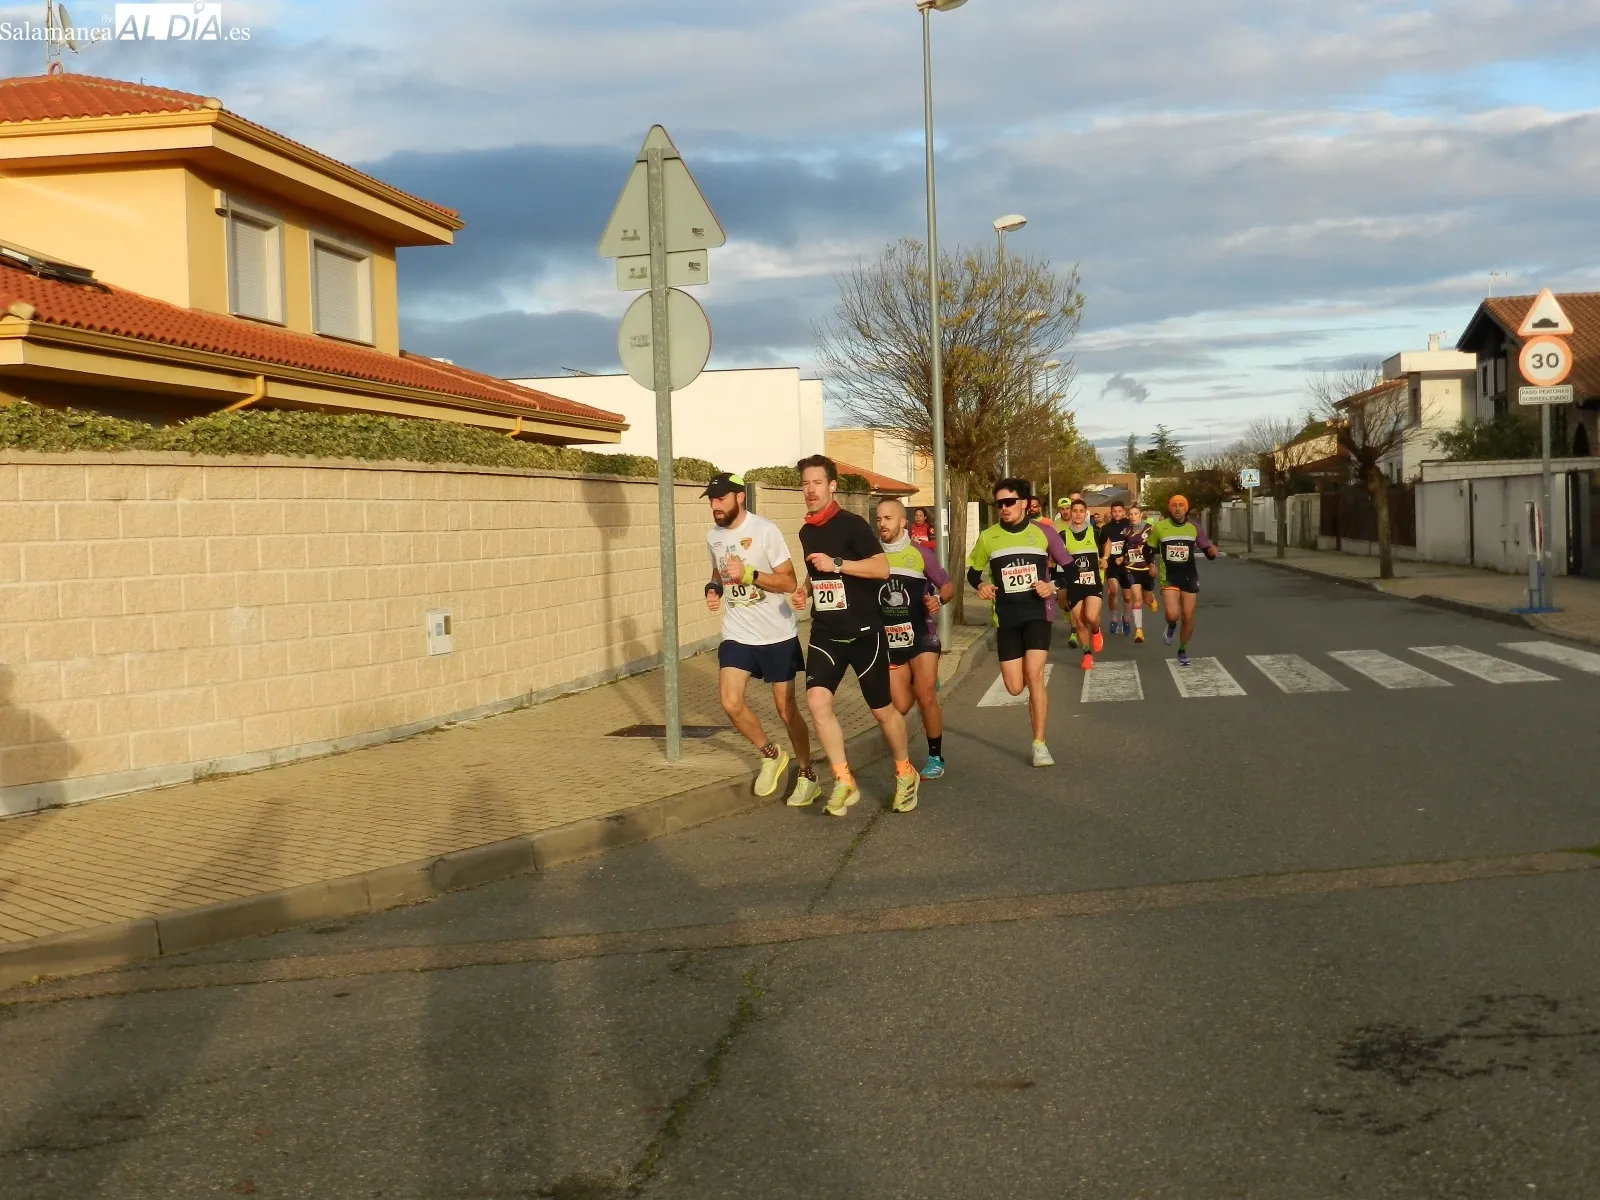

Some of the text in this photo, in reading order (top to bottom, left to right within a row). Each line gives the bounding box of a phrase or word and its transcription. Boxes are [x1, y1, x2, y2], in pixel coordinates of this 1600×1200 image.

[1531, 352, 1560, 369] 30
[1170, 550, 1185, 558] 245
[1008, 573, 1033, 587] 203
[731, 584, 747, 597] 60
[818, 590, 834, 604] 20
[887, 631, 910, 643] 243
